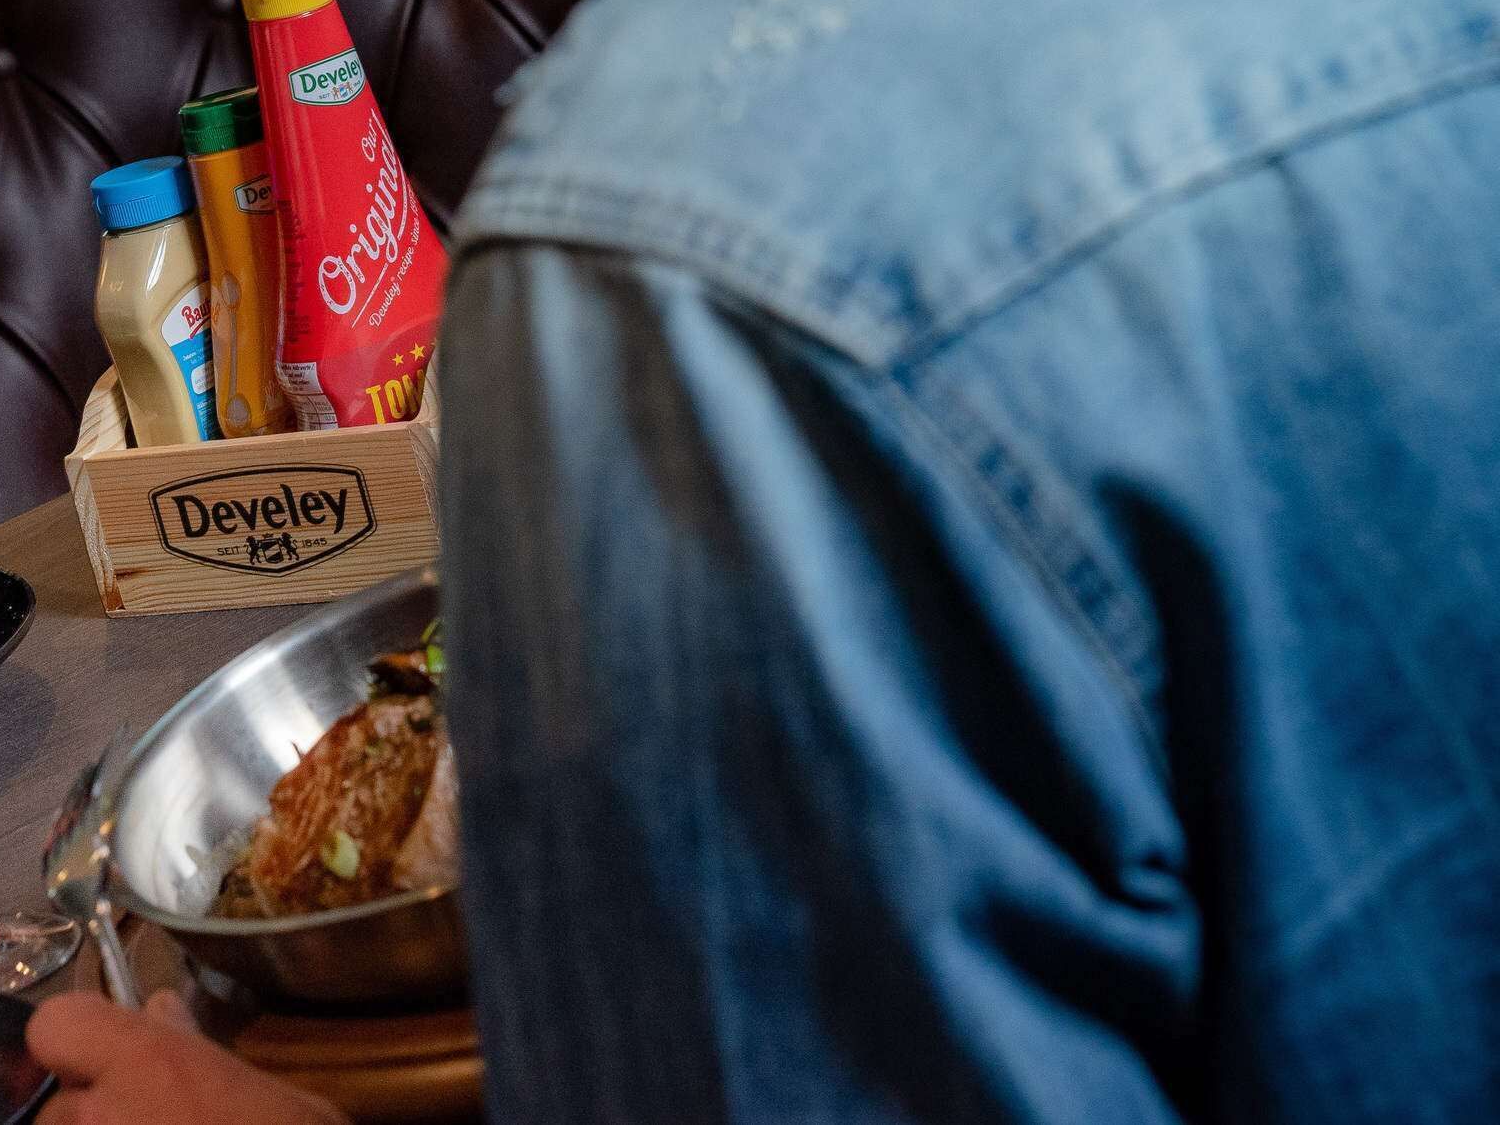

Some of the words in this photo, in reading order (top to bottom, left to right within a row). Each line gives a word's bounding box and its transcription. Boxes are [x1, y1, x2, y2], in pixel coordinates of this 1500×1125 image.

[299, 60, 364, 94] Develey
[318, 108, 398, 315] Original
[171, 483, 348, 539] Develey
[217, 545, 244, 557] SEIT
[301, 538, 328, 549] 1845
